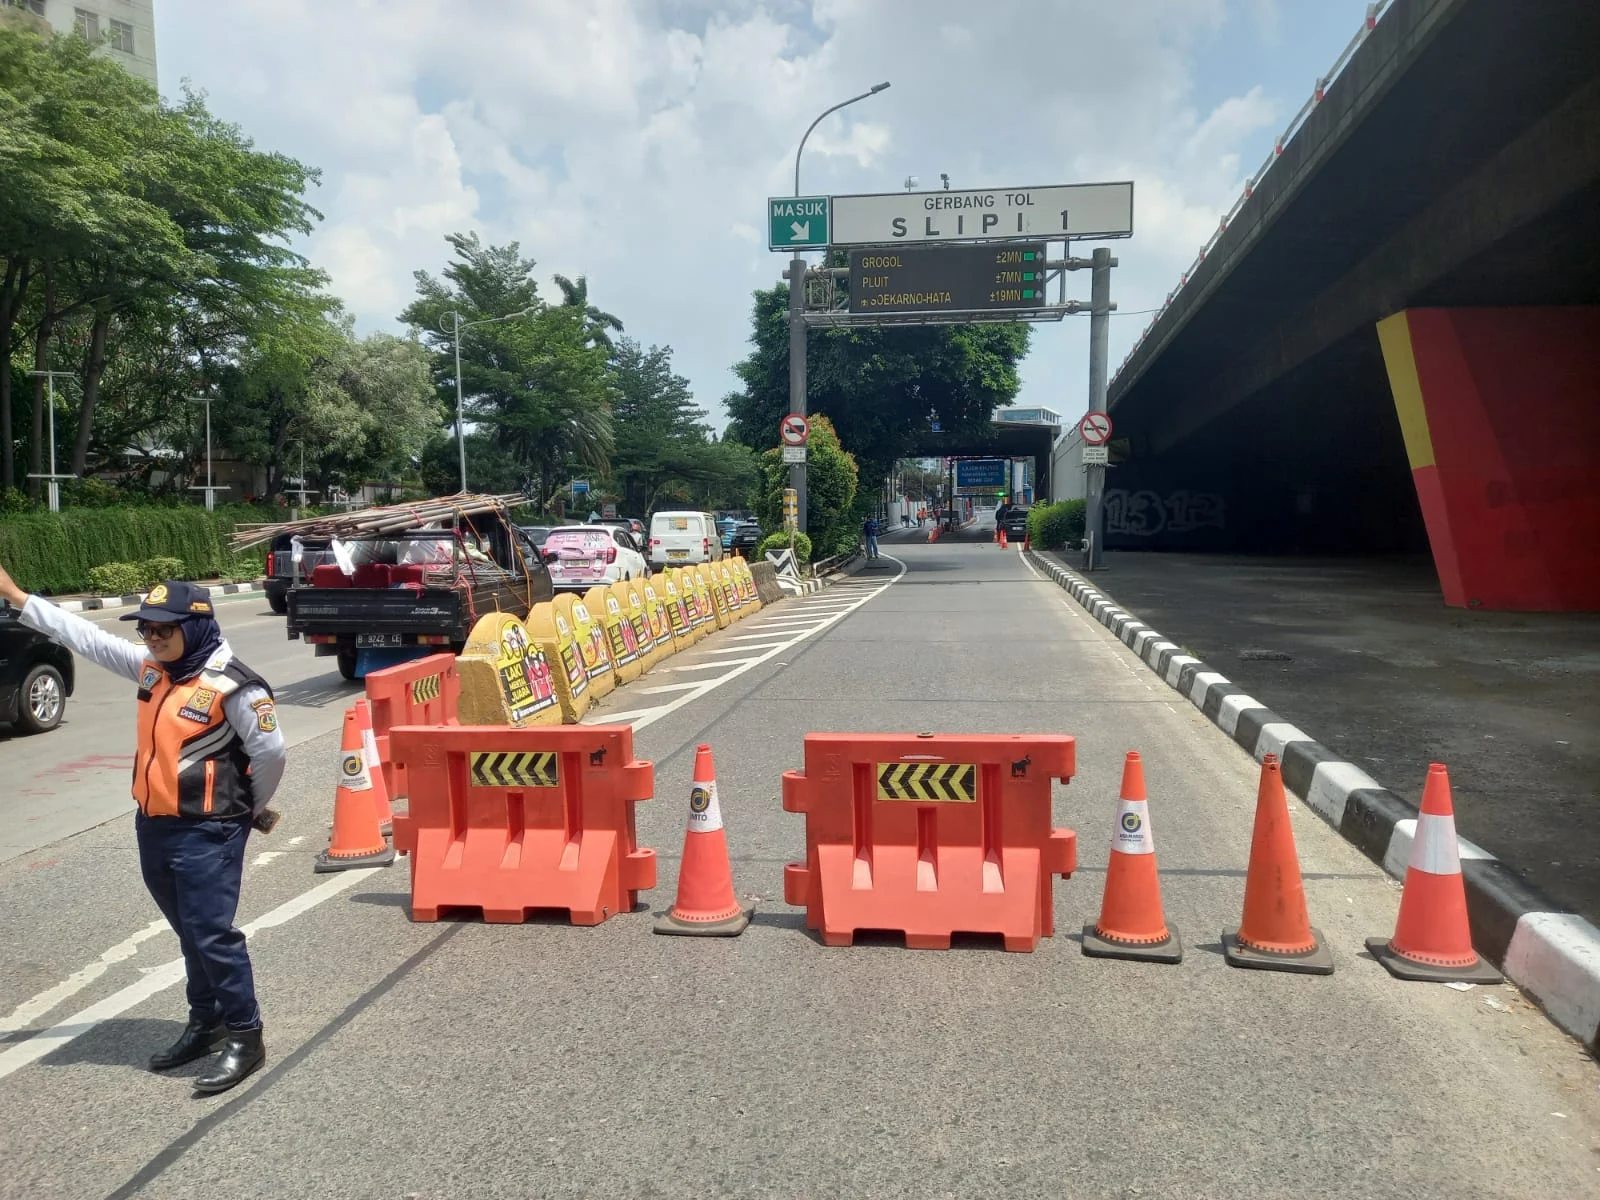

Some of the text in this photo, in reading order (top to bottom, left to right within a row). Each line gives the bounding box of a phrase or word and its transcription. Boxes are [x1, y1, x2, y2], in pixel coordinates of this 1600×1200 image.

[773, 202, 824, 217] MASUK
[924, 193, 1035, 210] GERBANG TOL
[1060, 210, 1068, 231] 1
[861, 252, 1022, 269] GROGOL ±2MN
[862, 276, 889, 289] PLUIT
[357, 634, 363, 644] B
[505, 663, 523, 682] LAKI
[180, 708, 209, 723] DISHUB
